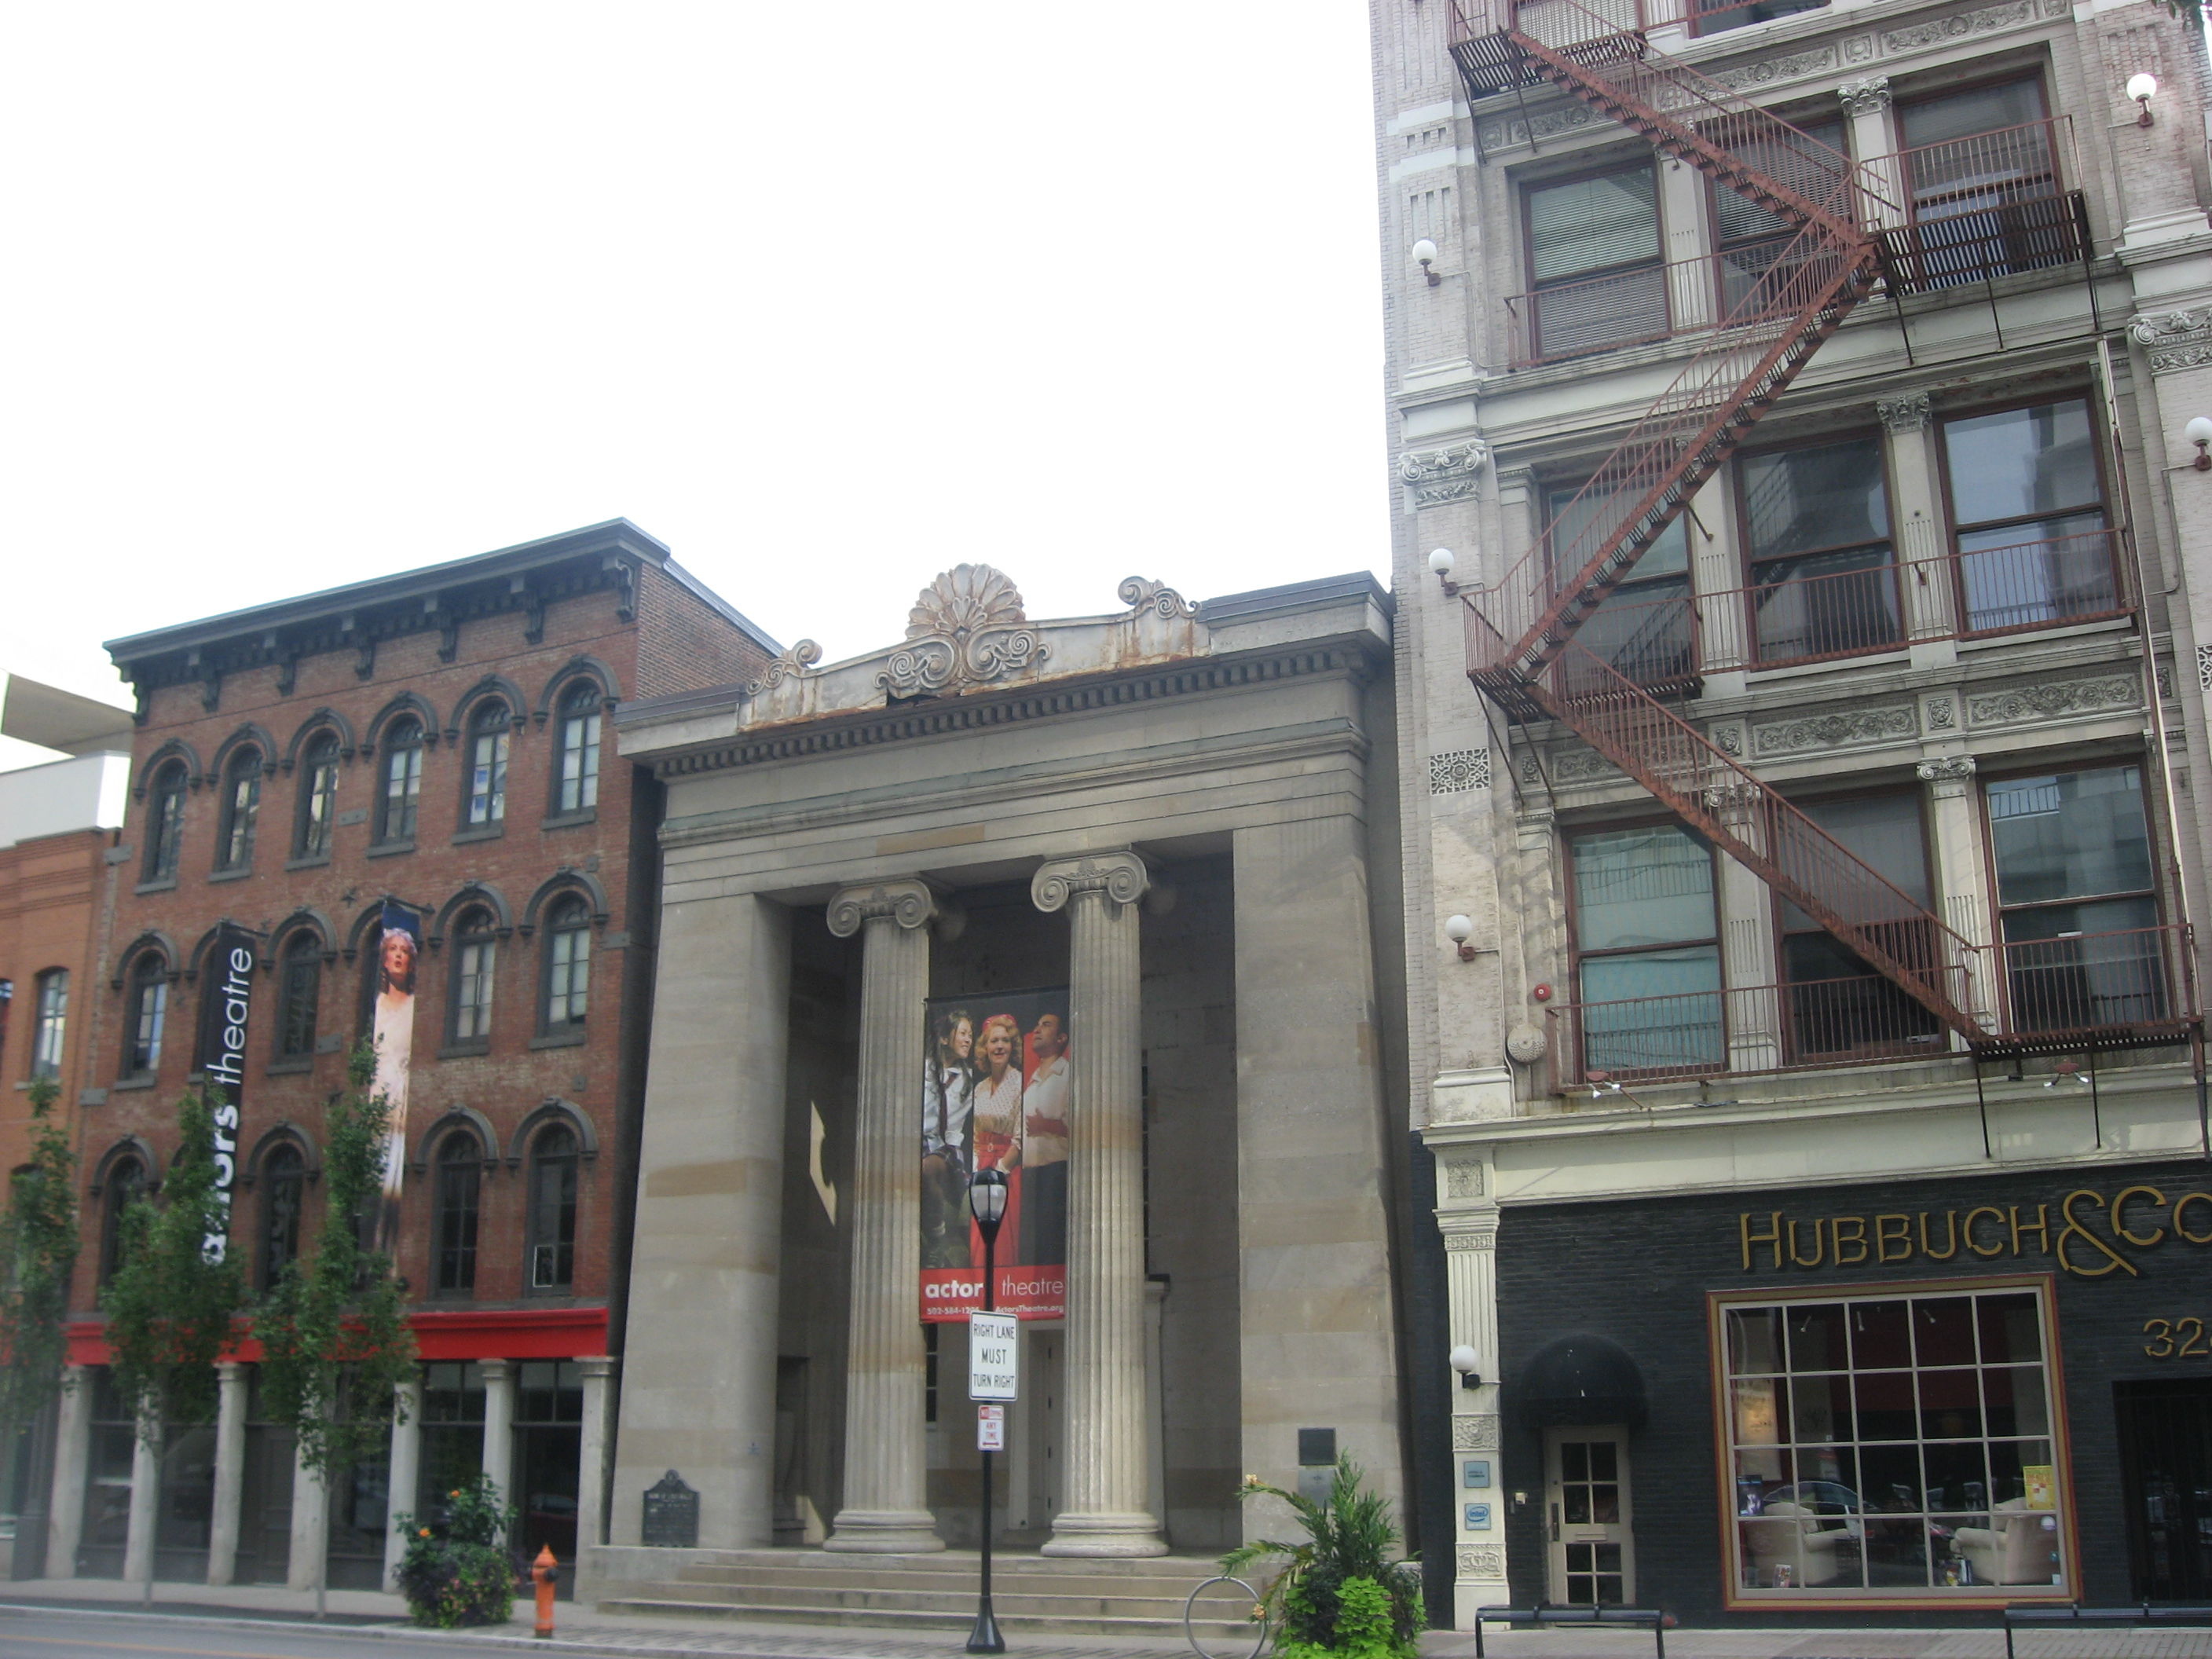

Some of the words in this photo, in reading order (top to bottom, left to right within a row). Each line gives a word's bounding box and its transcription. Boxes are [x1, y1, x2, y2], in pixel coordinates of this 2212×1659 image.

[206, 947, 252, 1085] theatre
[202, 1104, 239, 1266] aors
[925, 1280, 983, 1298] actor
[1002, 1274, 1064, 1296] theatre
[973, 1323, 994, 1338] RIGHT
[996, 1325, 1015, 1339] LANE
[2142, 1317, 2212, 1357] 32
[981, 1347, 1007, 1365] MUST
[973, 1373, 992, 1387] TURN
[994, 1375, 1015, 1389] RIGHT
